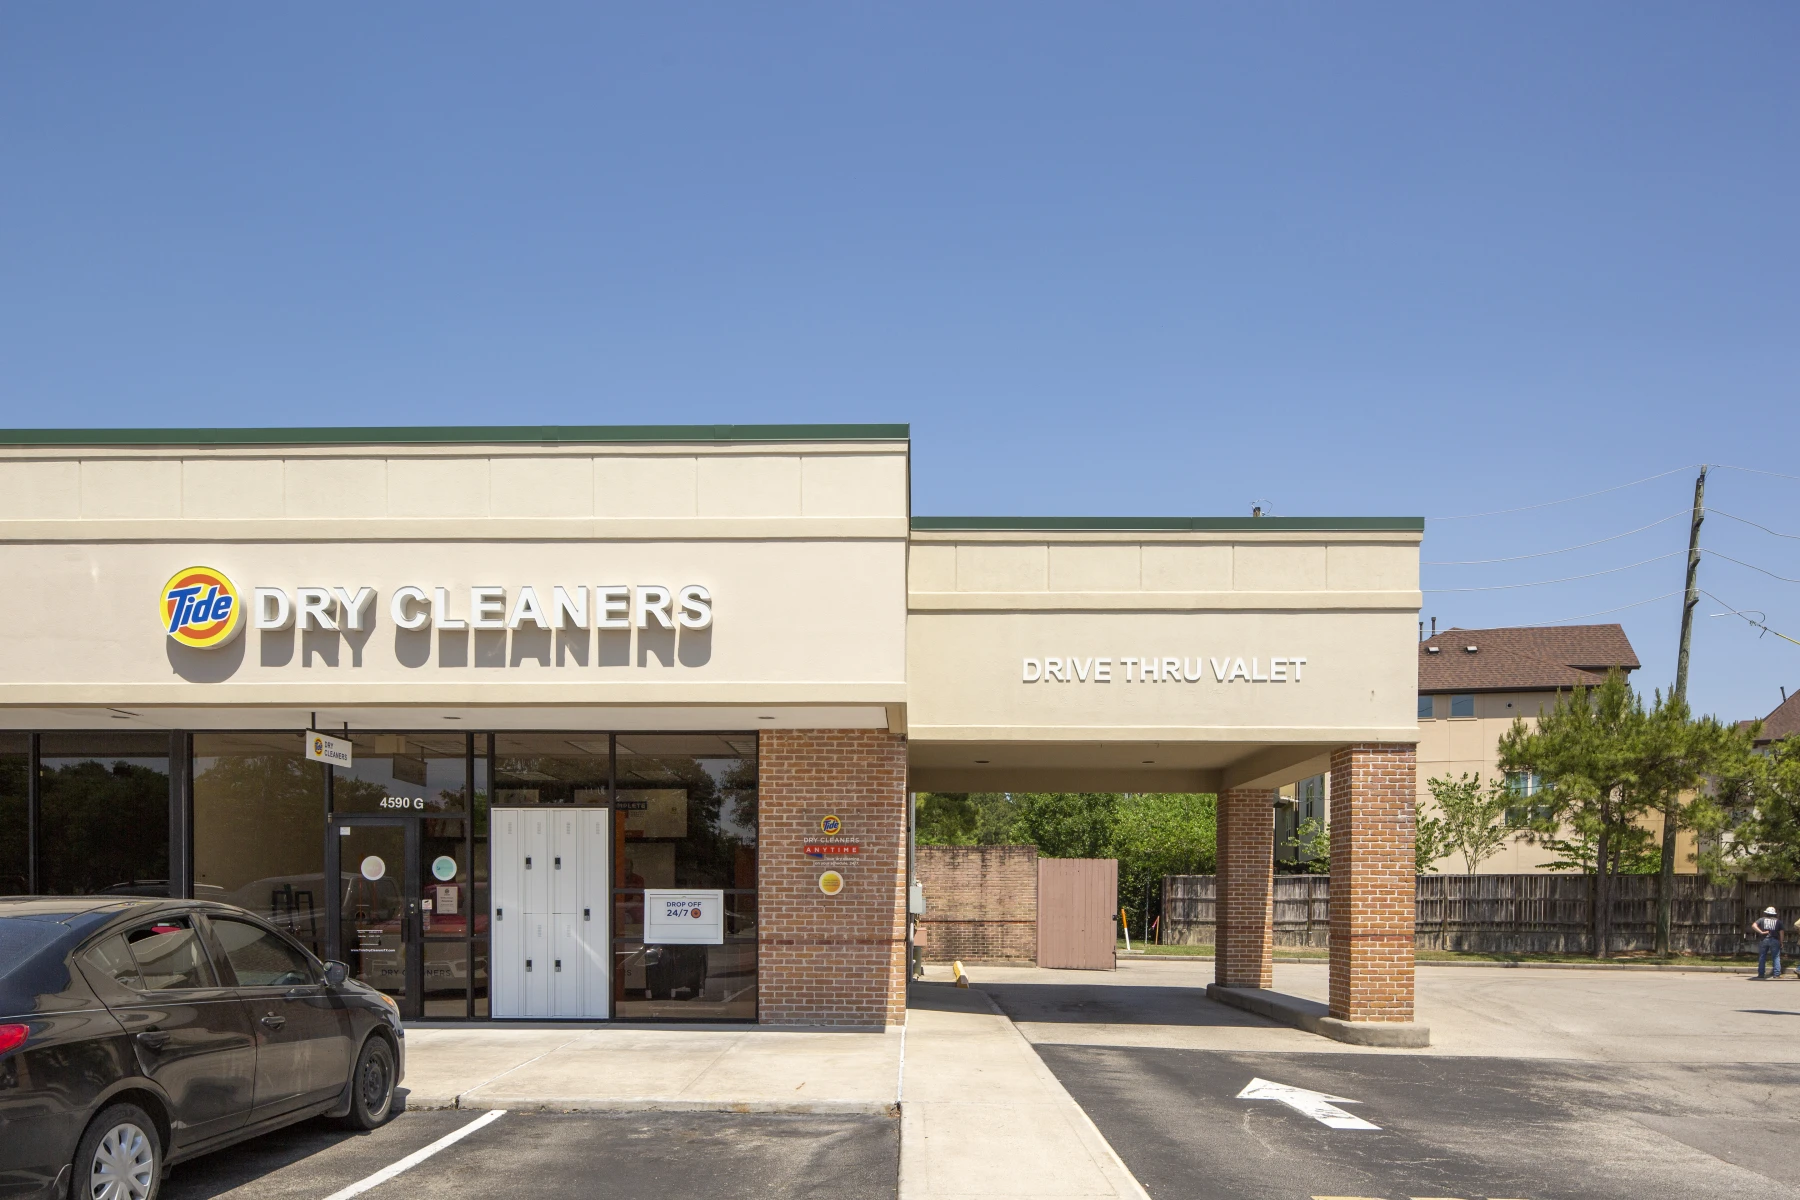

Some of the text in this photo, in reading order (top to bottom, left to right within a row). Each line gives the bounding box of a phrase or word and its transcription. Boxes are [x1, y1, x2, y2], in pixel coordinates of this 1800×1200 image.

[166, 584, 713, 634] Tide DRY CLEANERS
[1022, 657, 1307, 684] DRIVE THRU VALET
[324, 740, 334, 749] DRY
[324, 749, 348, 761] CLEANERS
[379, 796, 424, 810] 4590 G
[823, 819, 840, 832] Tide
[666, 908, 689, 918] 24/7
